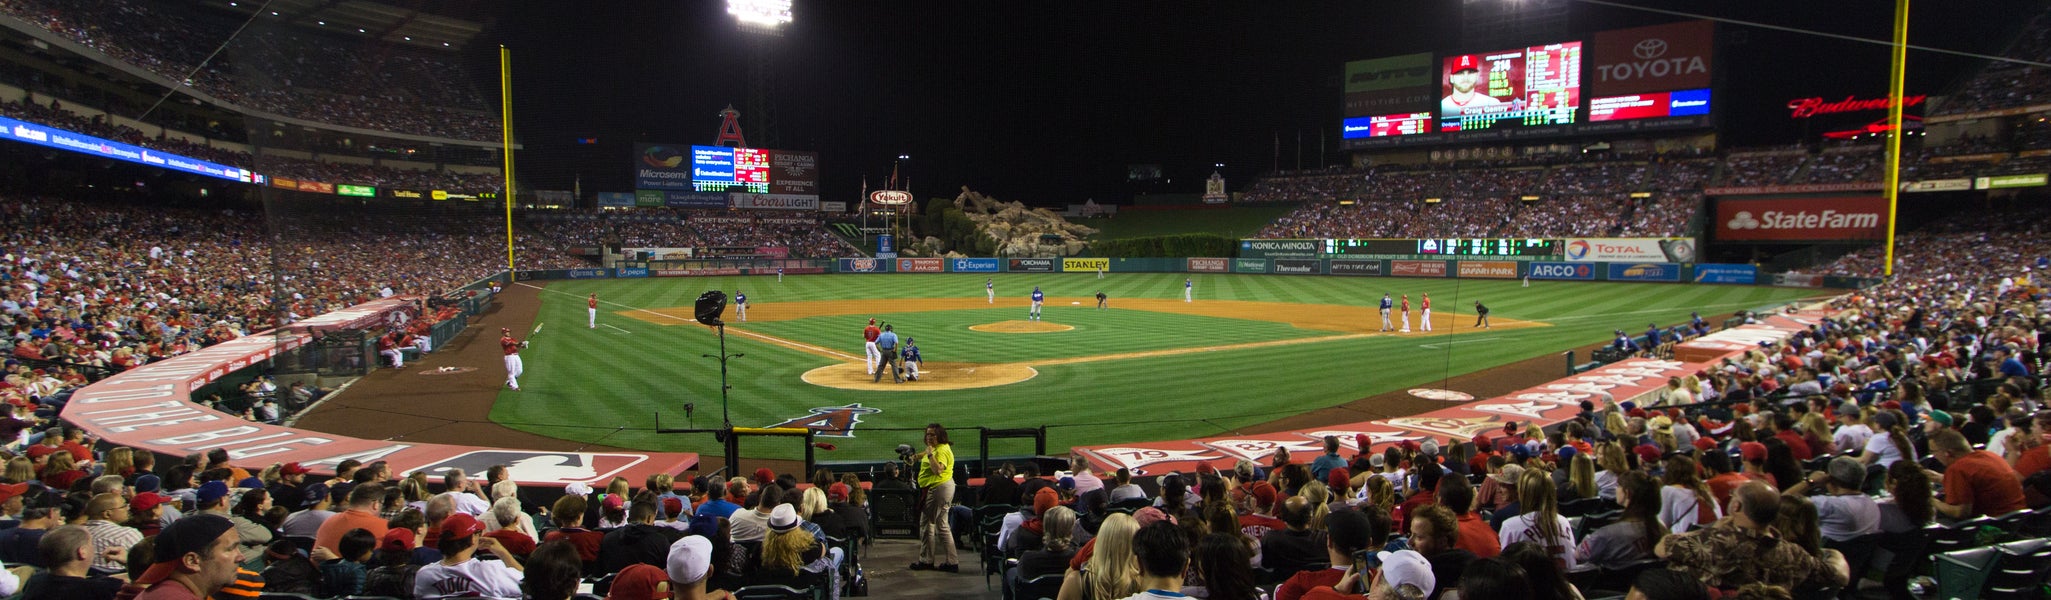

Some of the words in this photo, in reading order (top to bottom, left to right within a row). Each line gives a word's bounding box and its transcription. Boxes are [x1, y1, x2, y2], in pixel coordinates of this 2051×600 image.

[1597, 55, 1707, 81] TOYOTA
[1464, 106, 1483, 115] Craig
[1484, 104, 1508, 113] Gentry
[774, 154, 814, 162] PECHANGA
[640, 169, 687, 179] Microsemi
[752, 194, 785, 208] Coors
[786, 198, 814, 208] LIGHT
[878, 193, 906, 201] Yakult
[1251, 242, 1280, 250] KONICA
[1281, 242, 1315, 250] MINOLTA
[1595, 244, 1645, 253] TOTAL
[968, 262, 995, 270] Experian
[1064, 260, 1108, 269] STANLEY
[1276, 264, 1311, 272] Thermador
[627, 269, 646, 277] pepsi
[1533, 265, 1575, 276] ARCO
